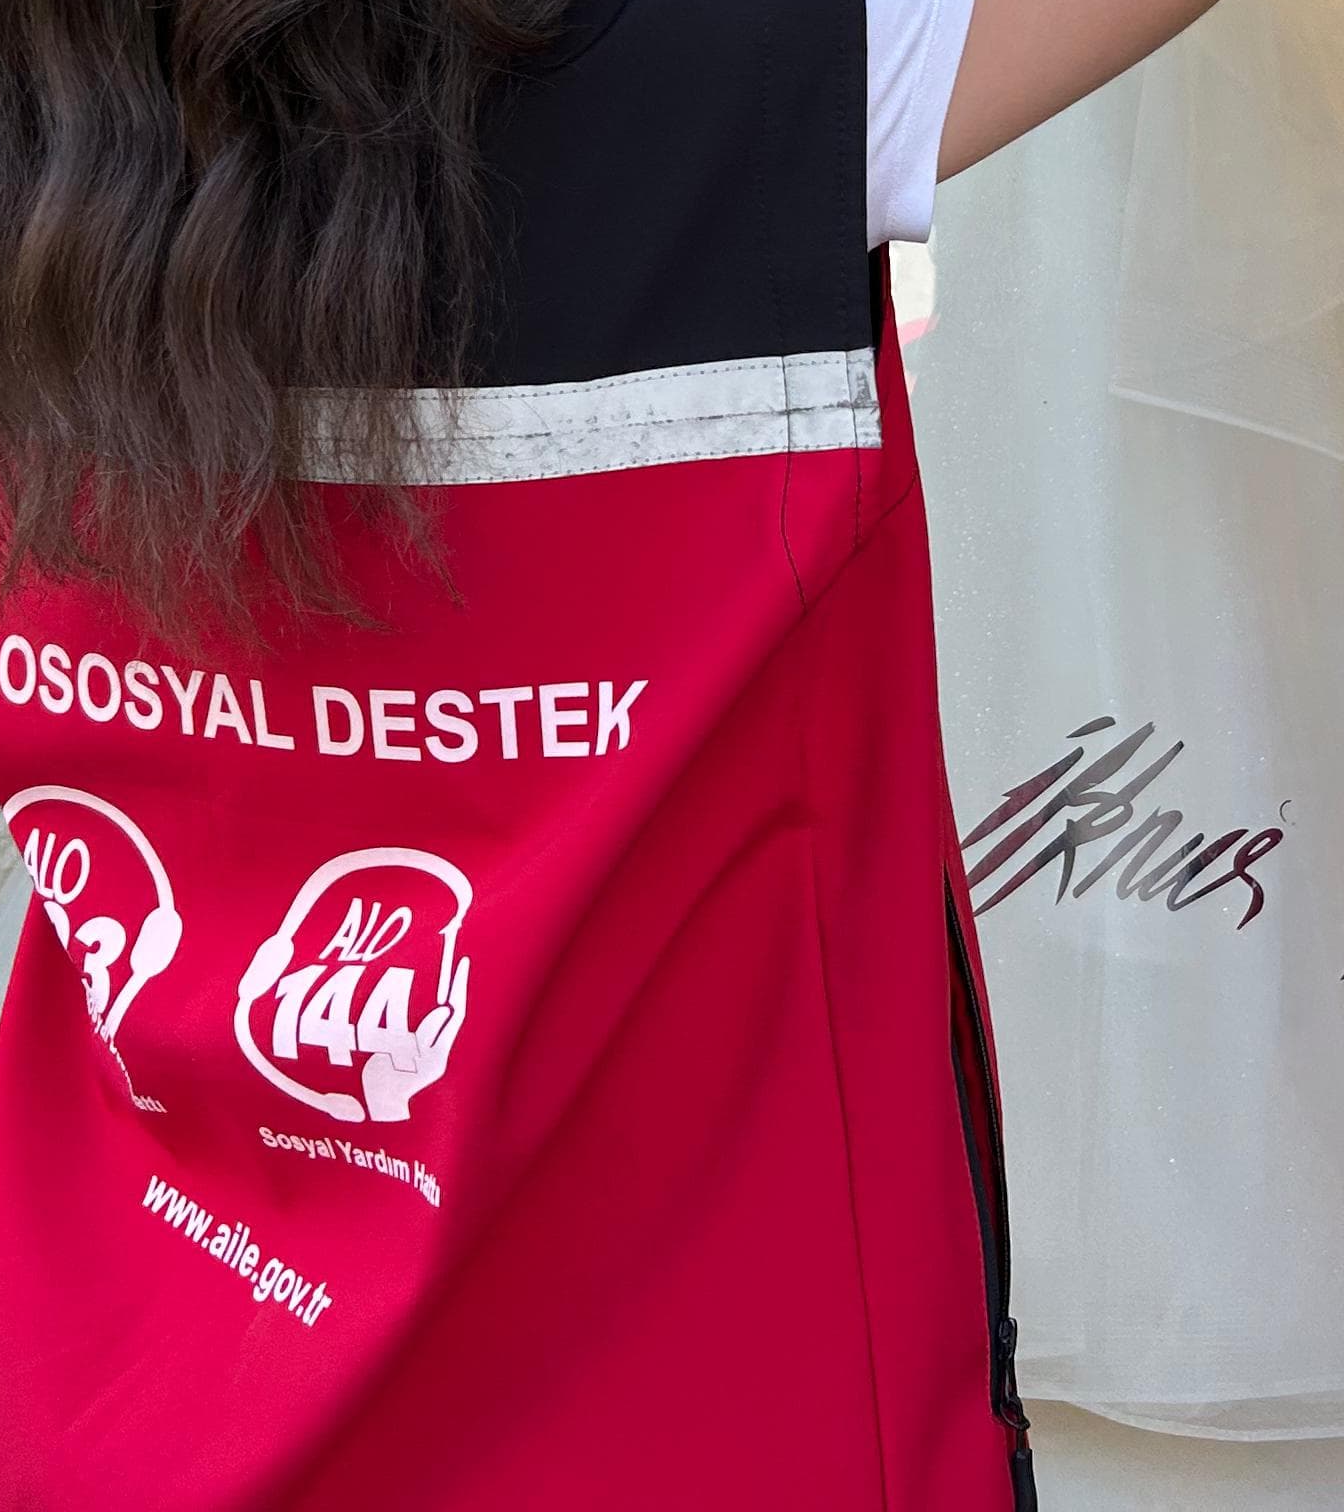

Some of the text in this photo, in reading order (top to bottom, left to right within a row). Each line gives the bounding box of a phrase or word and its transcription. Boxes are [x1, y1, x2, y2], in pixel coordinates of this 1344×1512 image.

[313, 680, 649, 763] DESTEK
[22, 827, 90, 905] ALO
[319, 897, 413, 964] ALO
[272, 964, 420, 1073] 144
[259, 1126, 336, 1159] Sosyal
[335, 1139, 411, 1184] Yardım
[142, 1175, 333, 1327] www.aile.gov.tr
